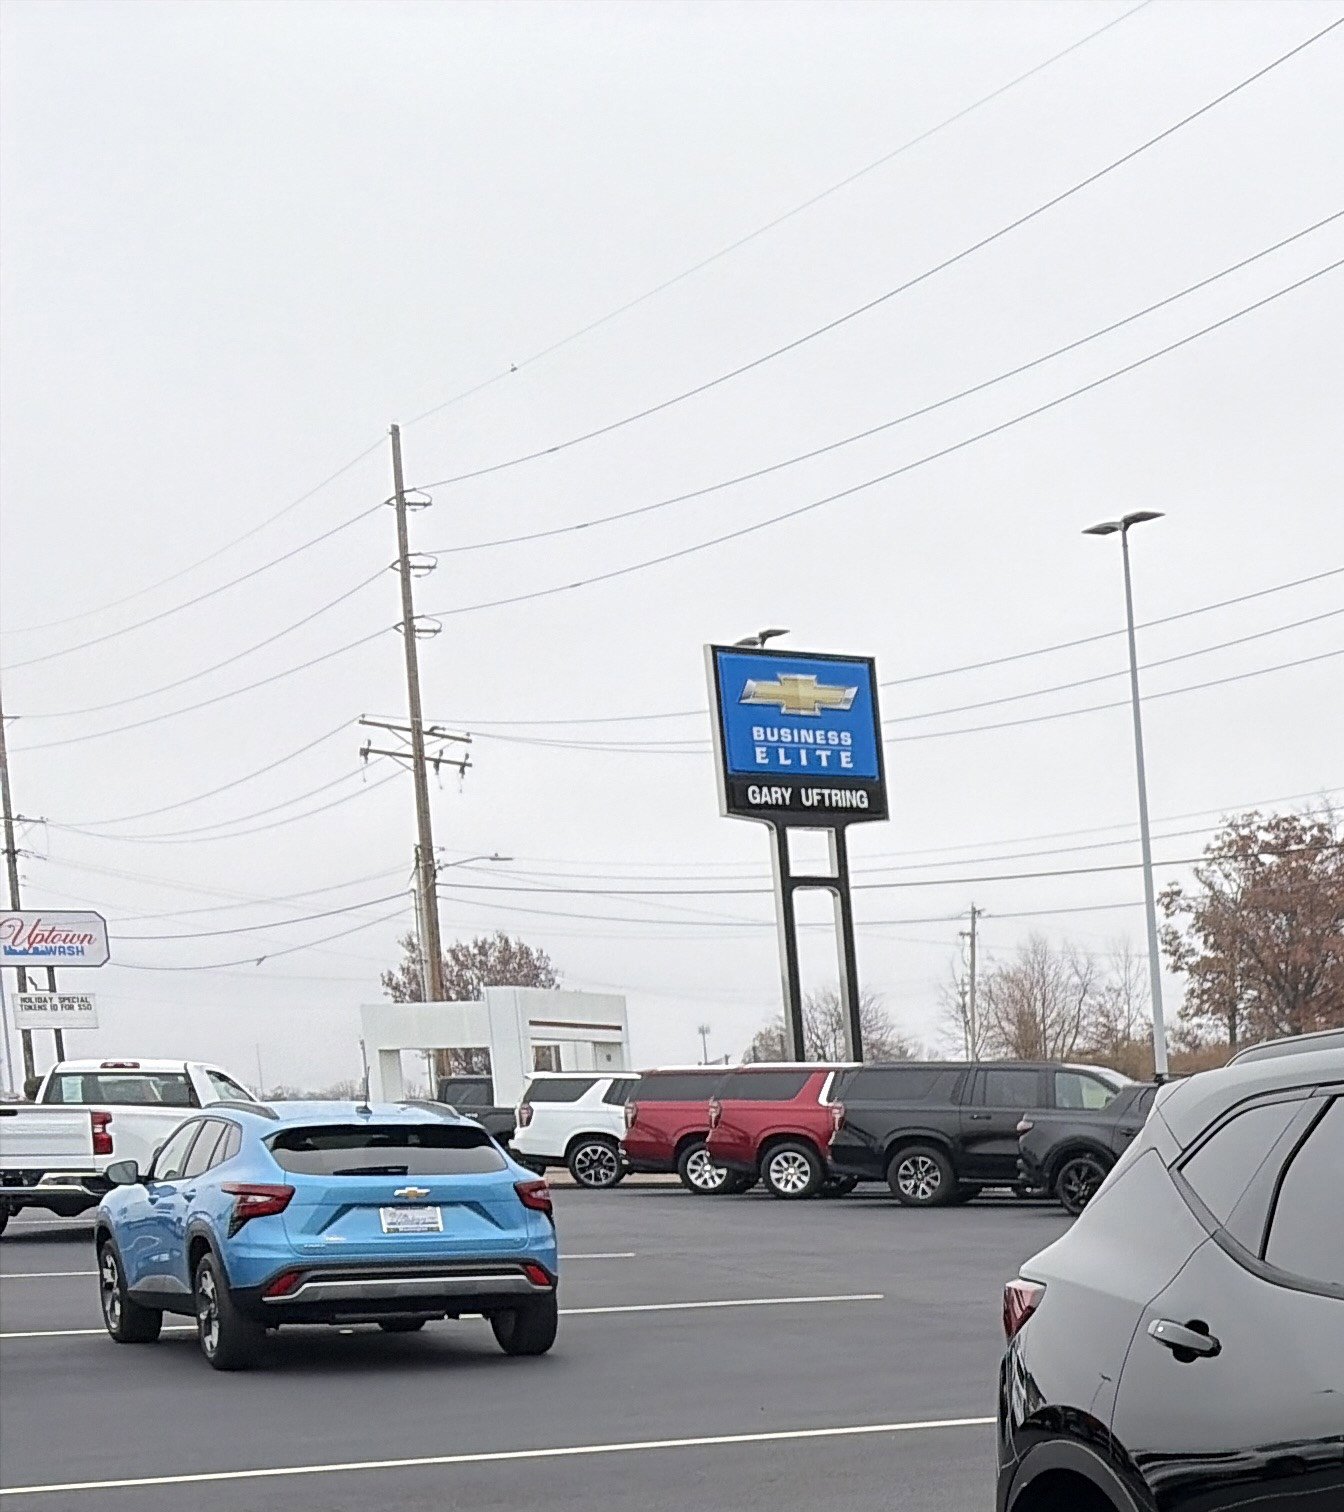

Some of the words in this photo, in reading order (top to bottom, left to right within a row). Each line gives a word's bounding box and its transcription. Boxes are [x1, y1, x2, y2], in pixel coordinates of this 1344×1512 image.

[752, 726, 852, 746] BUSINESS
[755, 746, 854, 769] ELITE
[747, 785, 793, 806] GARY
[801, 787, 869, 809] UFTRING
[0, 917, 97, 952] Uptown
[46, 945, 85, 956] WASH
[20, 996, 54, 1004] HOLIDAY
[58, 996, 89, 1004] SPECIAL
